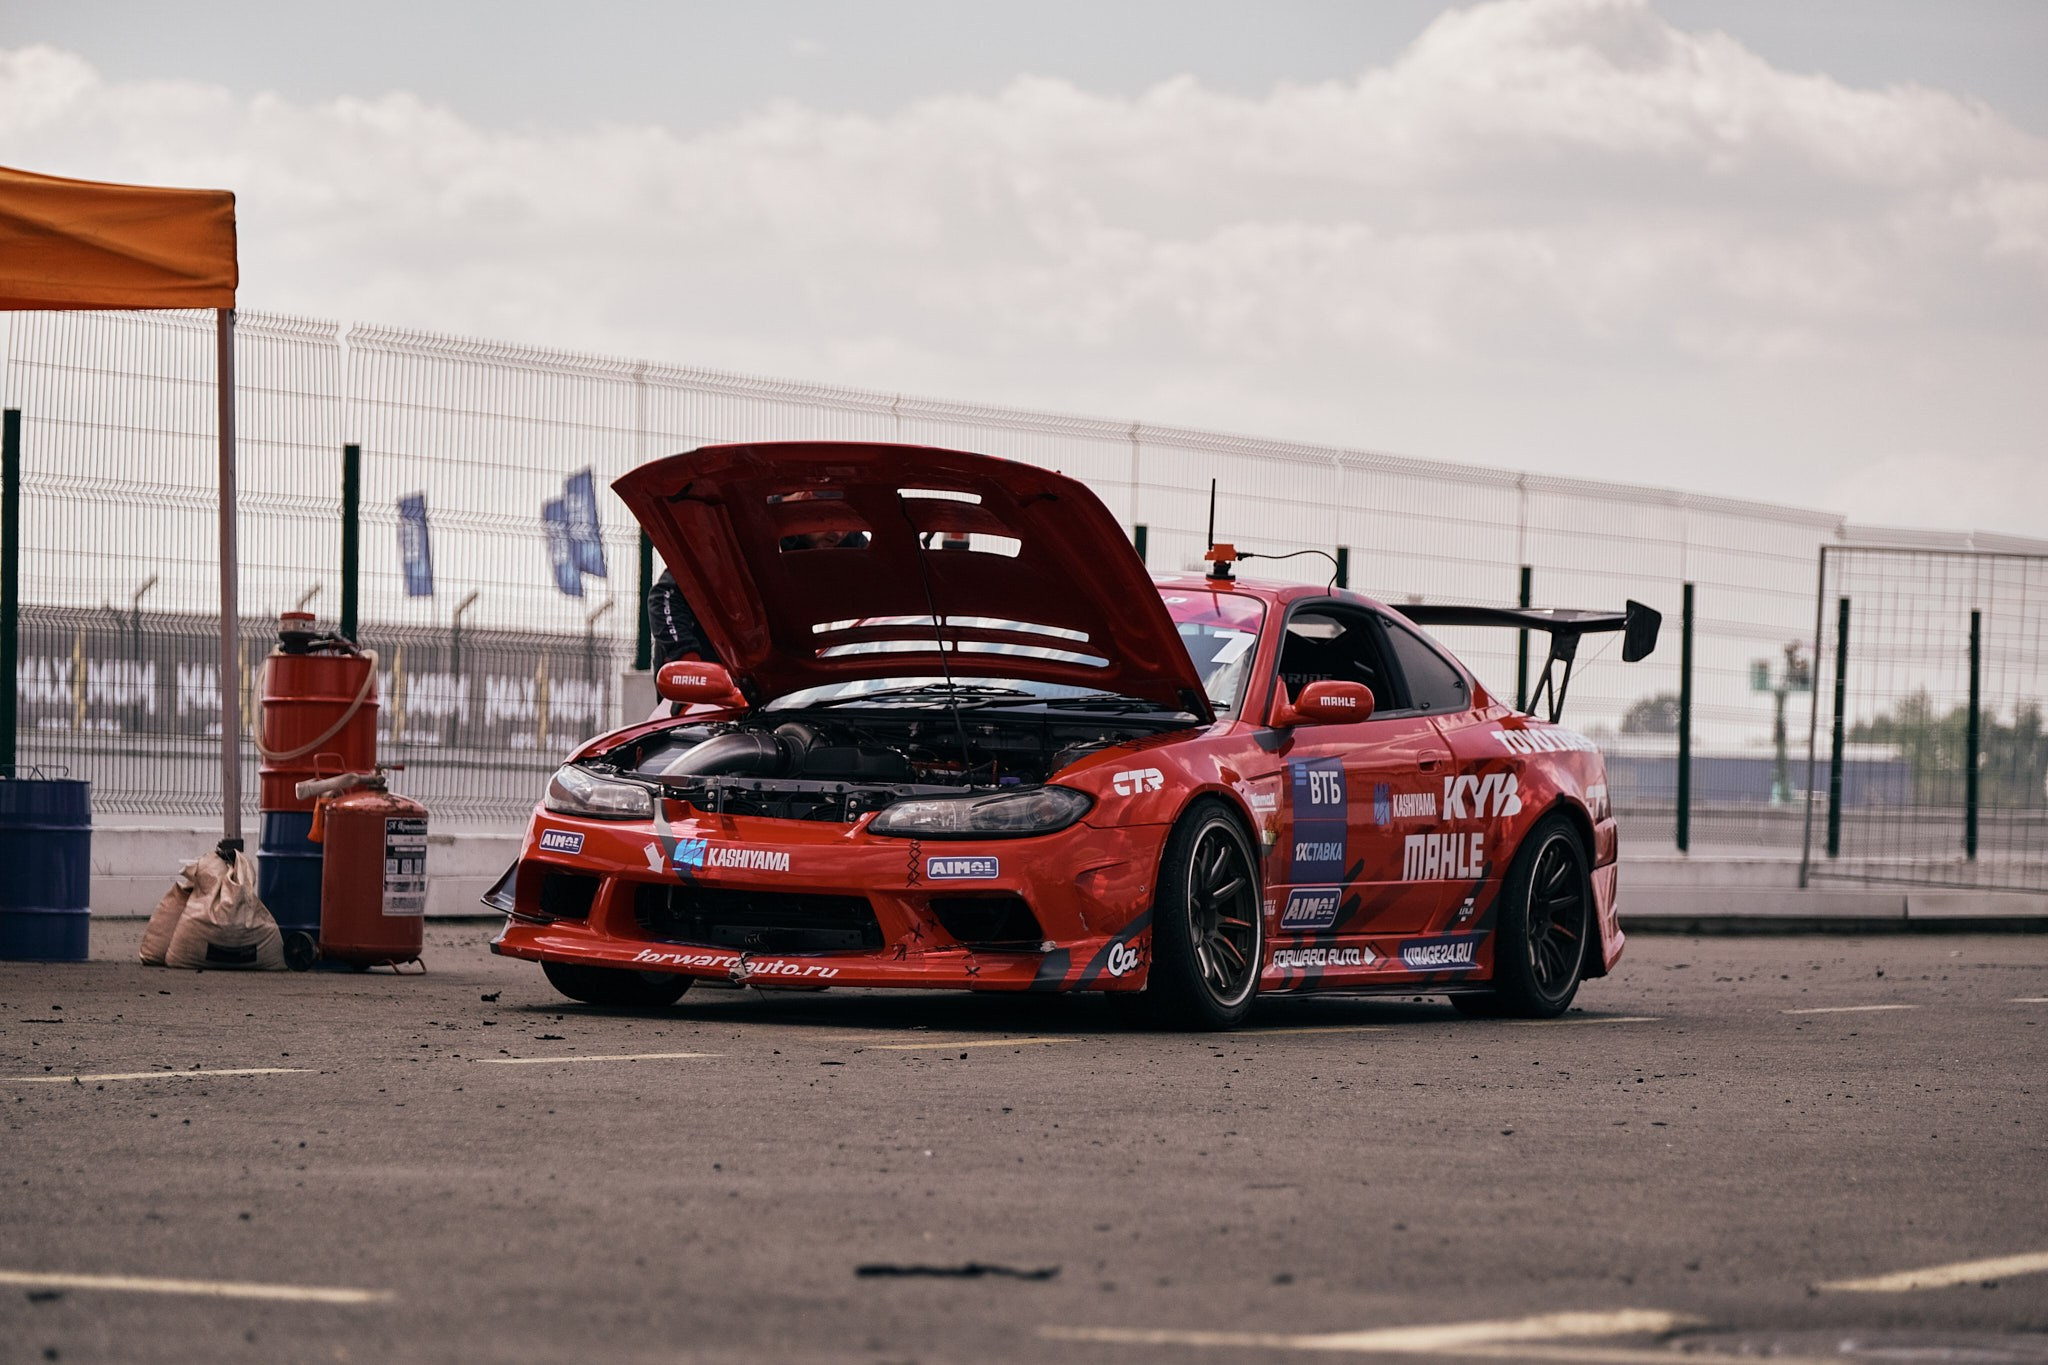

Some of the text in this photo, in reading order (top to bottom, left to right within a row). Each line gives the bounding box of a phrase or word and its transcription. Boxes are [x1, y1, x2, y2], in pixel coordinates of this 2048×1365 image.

[672, 675, 706, 686] MAHLE
[1320, 696, 1356, 707] MAHLE
[1113, 767, 1164, 796] CTR
[1309, 770, 1341, 805] ВТБ
[1393, 792, 1436, 818] KASHIYAMA
[1442, 773, 1522, 820] KYB
[541, 831, 581, 850] AIMOL
[707, 848, 790, 872] KASHIYAMA
[930, 861, 995, 876] AIMOL
[1402, 832, 1484, 881] MAHLE
[1284, 897, 1334, 920] AIMOL
[1273, 948, 1361, 968] FORWARD AUTO
[1404, 942, 1473, 966] VIRAGE24.RU
